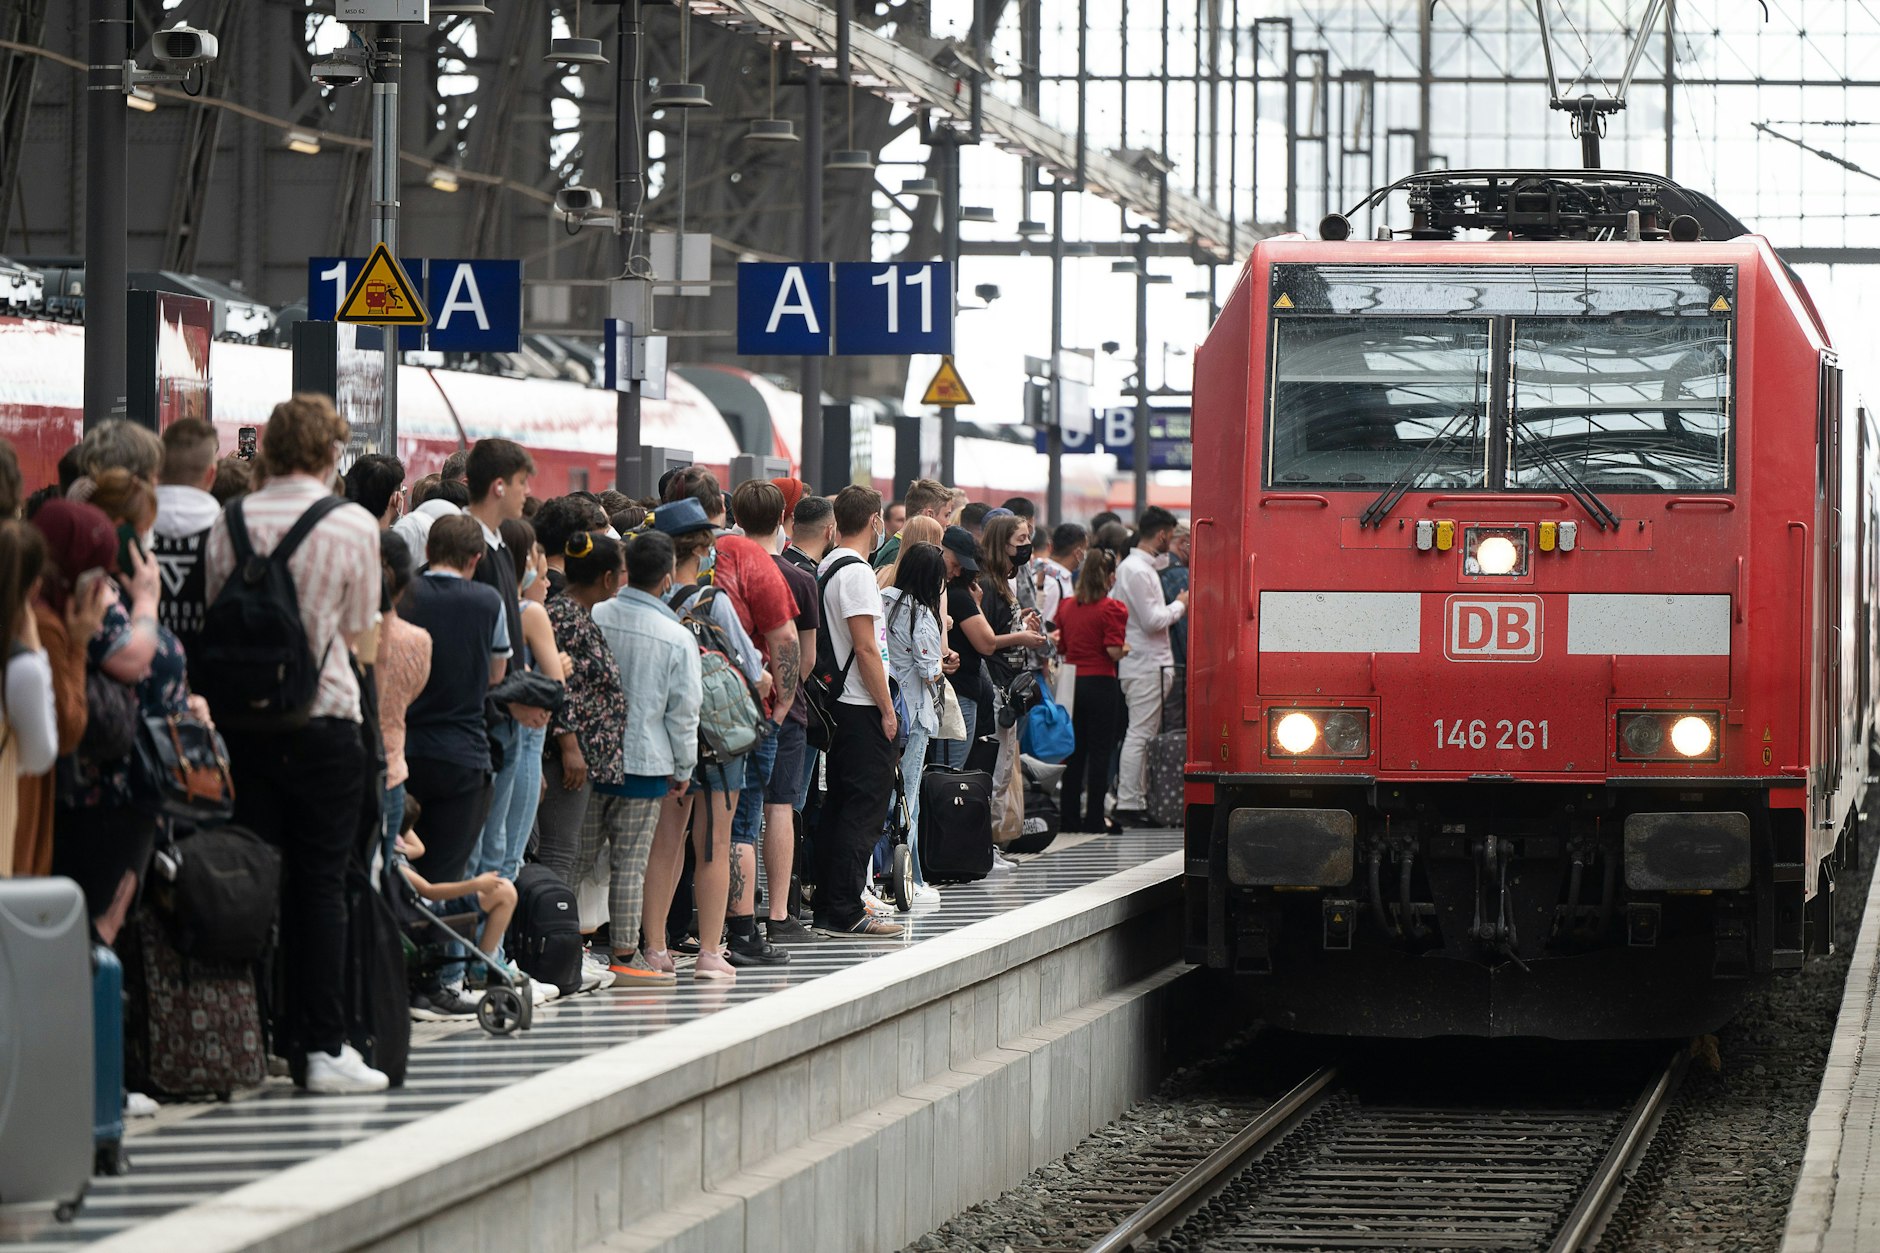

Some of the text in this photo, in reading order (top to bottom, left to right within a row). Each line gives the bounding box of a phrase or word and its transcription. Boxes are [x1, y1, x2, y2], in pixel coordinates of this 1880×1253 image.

[436, 263, 490, 330] A
[765, 266, 821, 333] A
[871, 265, 932, 333] 11
[1105, 408, 1135, 446] B
[1458, 606, 1530, 650] DB
[1434, 719, 1548, 749] 146 261
